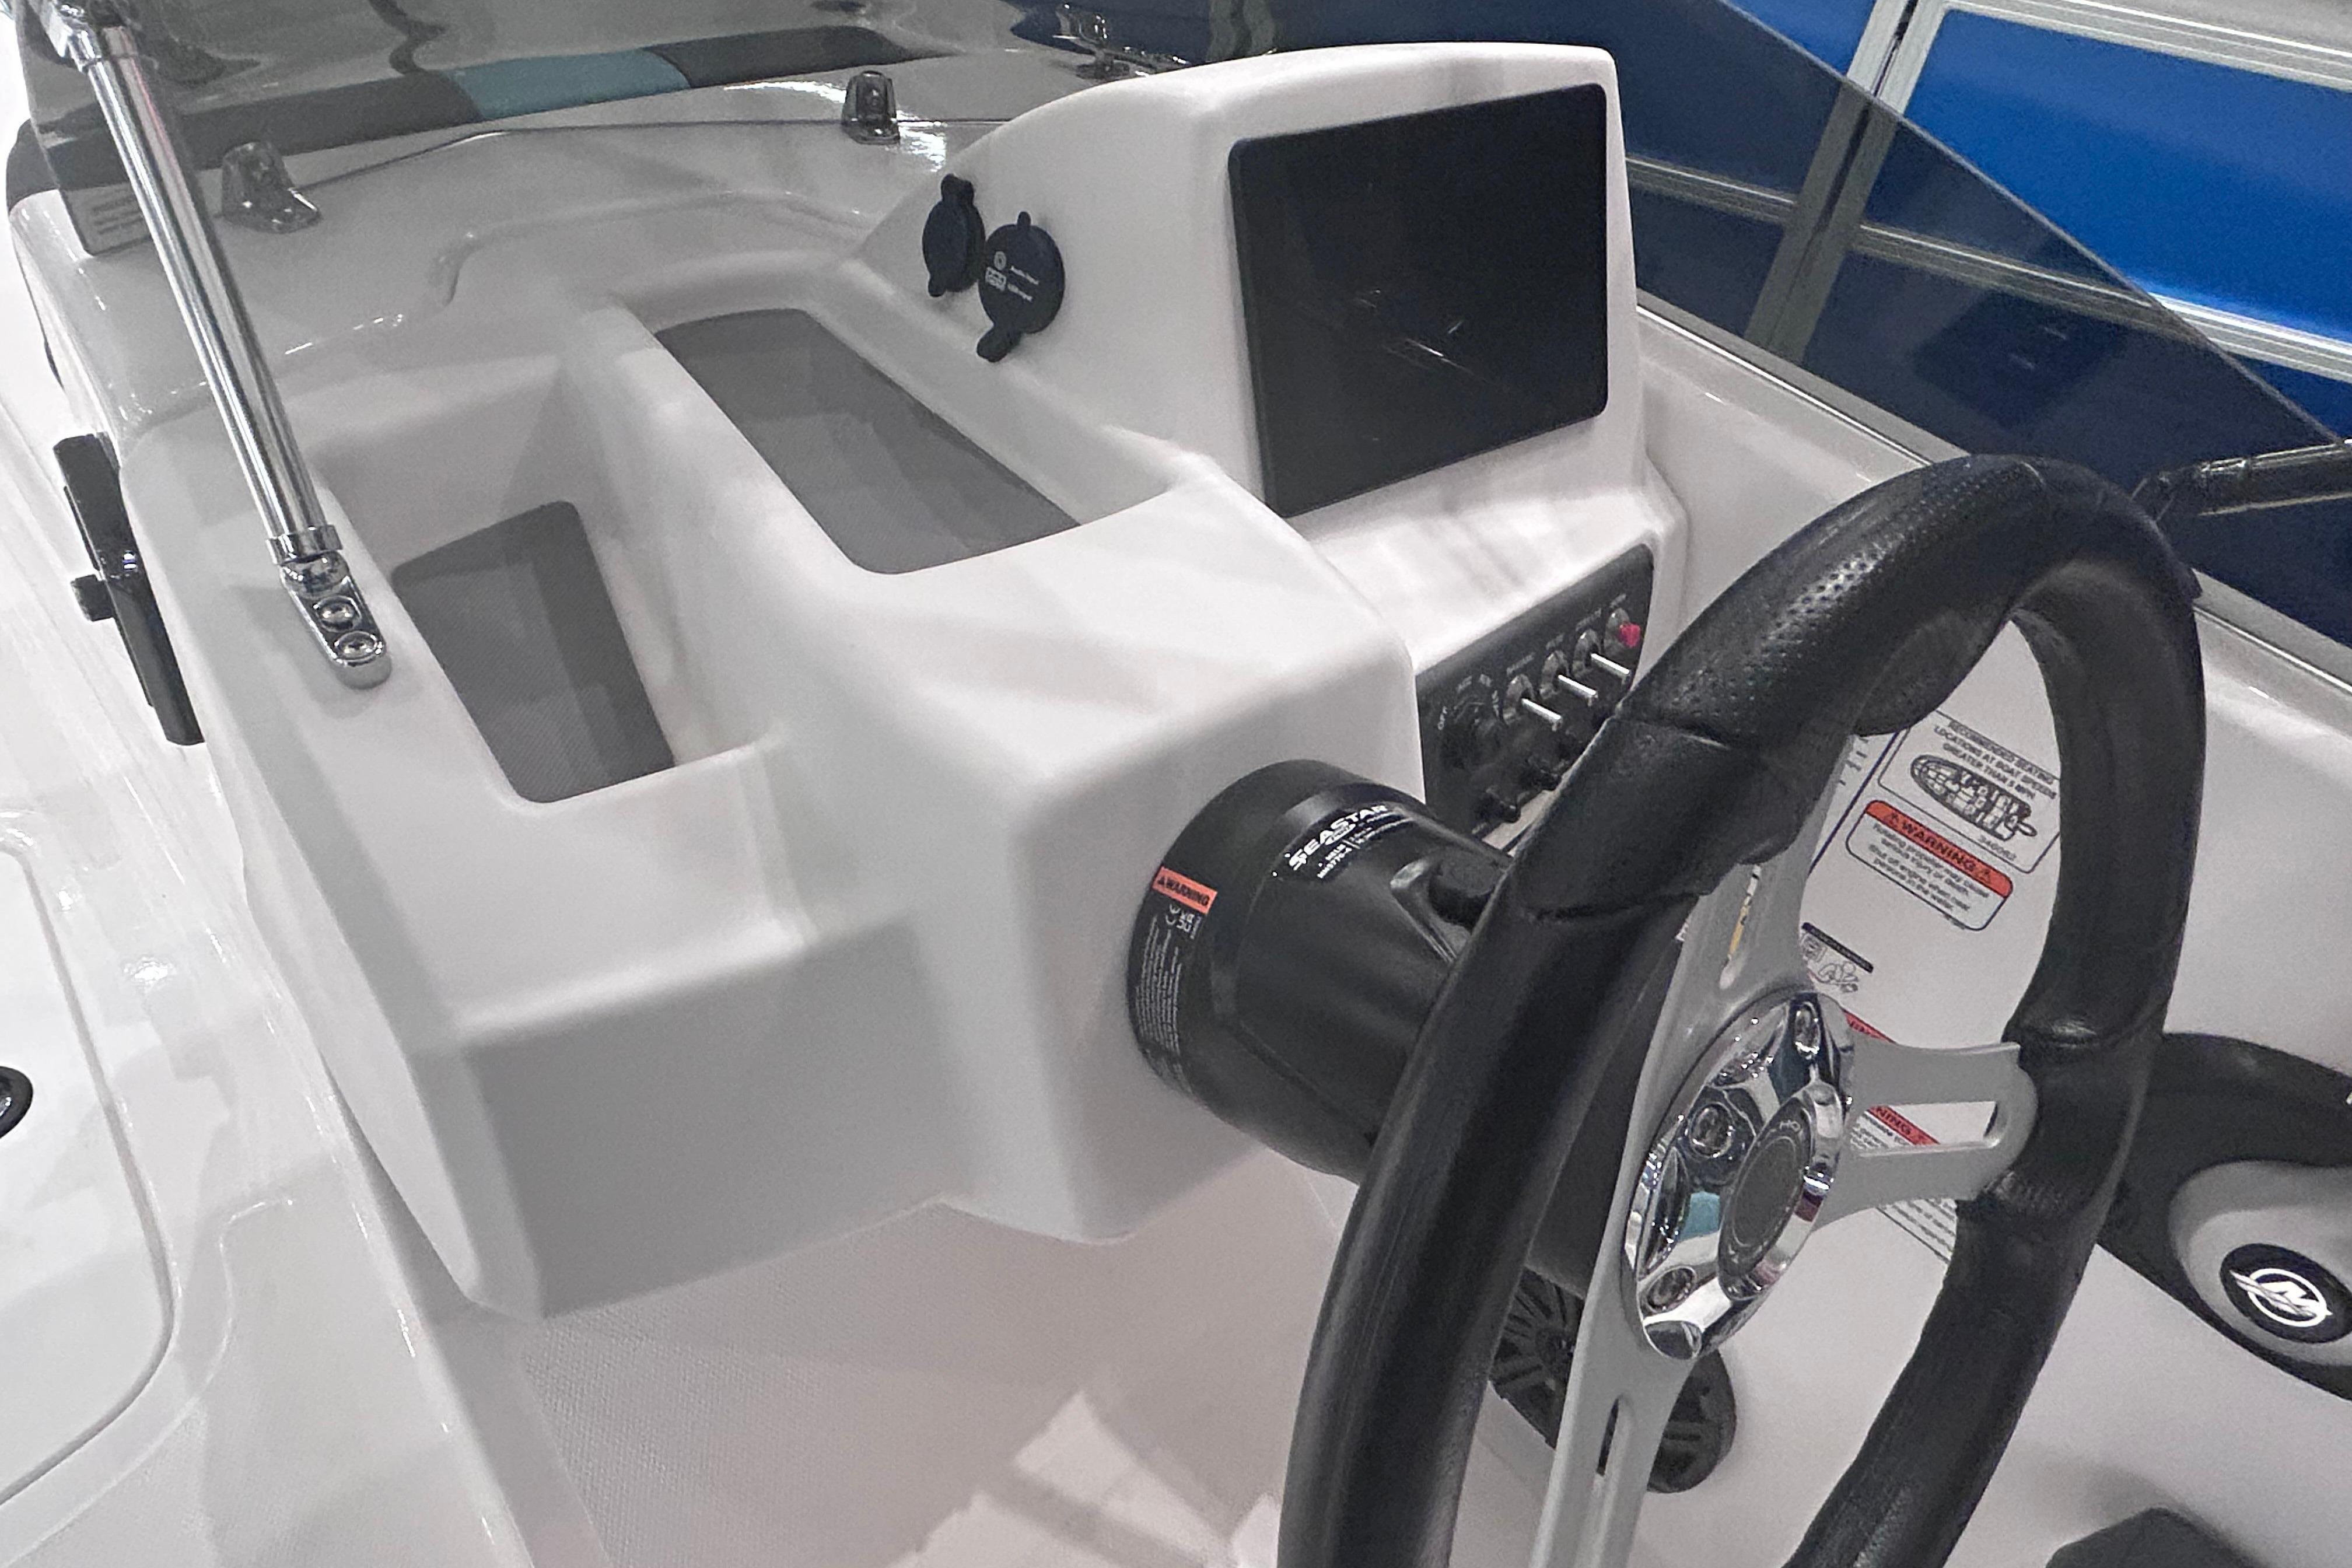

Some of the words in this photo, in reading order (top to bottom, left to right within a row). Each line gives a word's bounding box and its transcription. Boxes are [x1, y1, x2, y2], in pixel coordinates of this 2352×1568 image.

[1982, 753, 1995, 764] AT
[1994, 760, 2020, 779] BOAT
[1899, 819, 1977, 872] WARNING
[1875, 1105, 1912, 1135] NING
